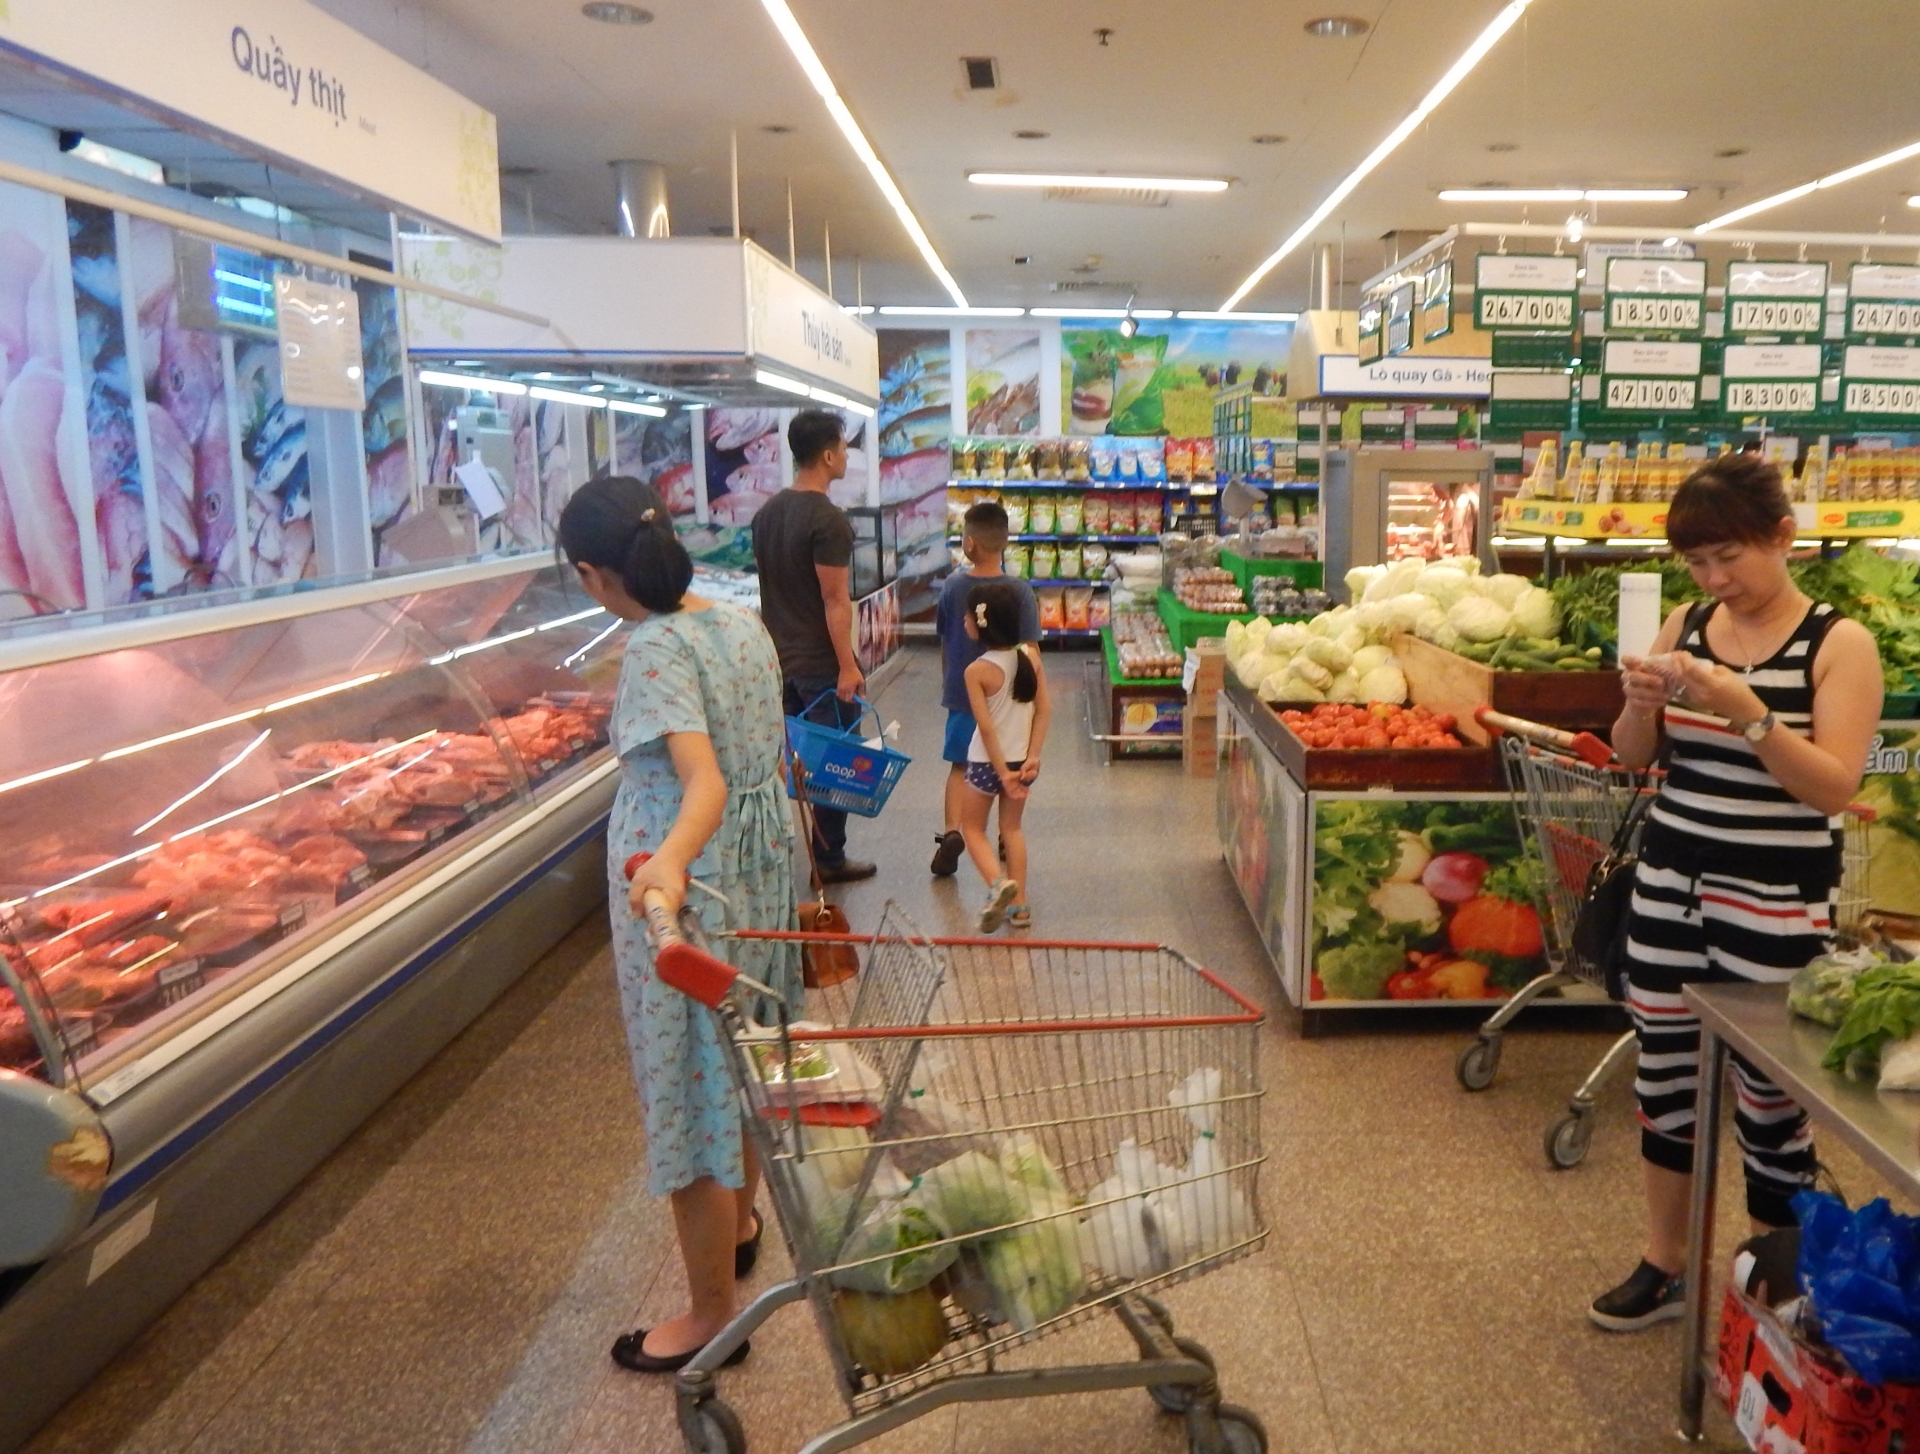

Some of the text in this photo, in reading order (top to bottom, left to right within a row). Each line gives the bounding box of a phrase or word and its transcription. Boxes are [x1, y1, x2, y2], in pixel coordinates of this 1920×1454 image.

[231, 26, 347, 127] Quầy thịt
[1370, 366, 1388, 381] Lò
[1392, 369, 1428, 384] quay
[1432, 367, 1452, 382] Gà
